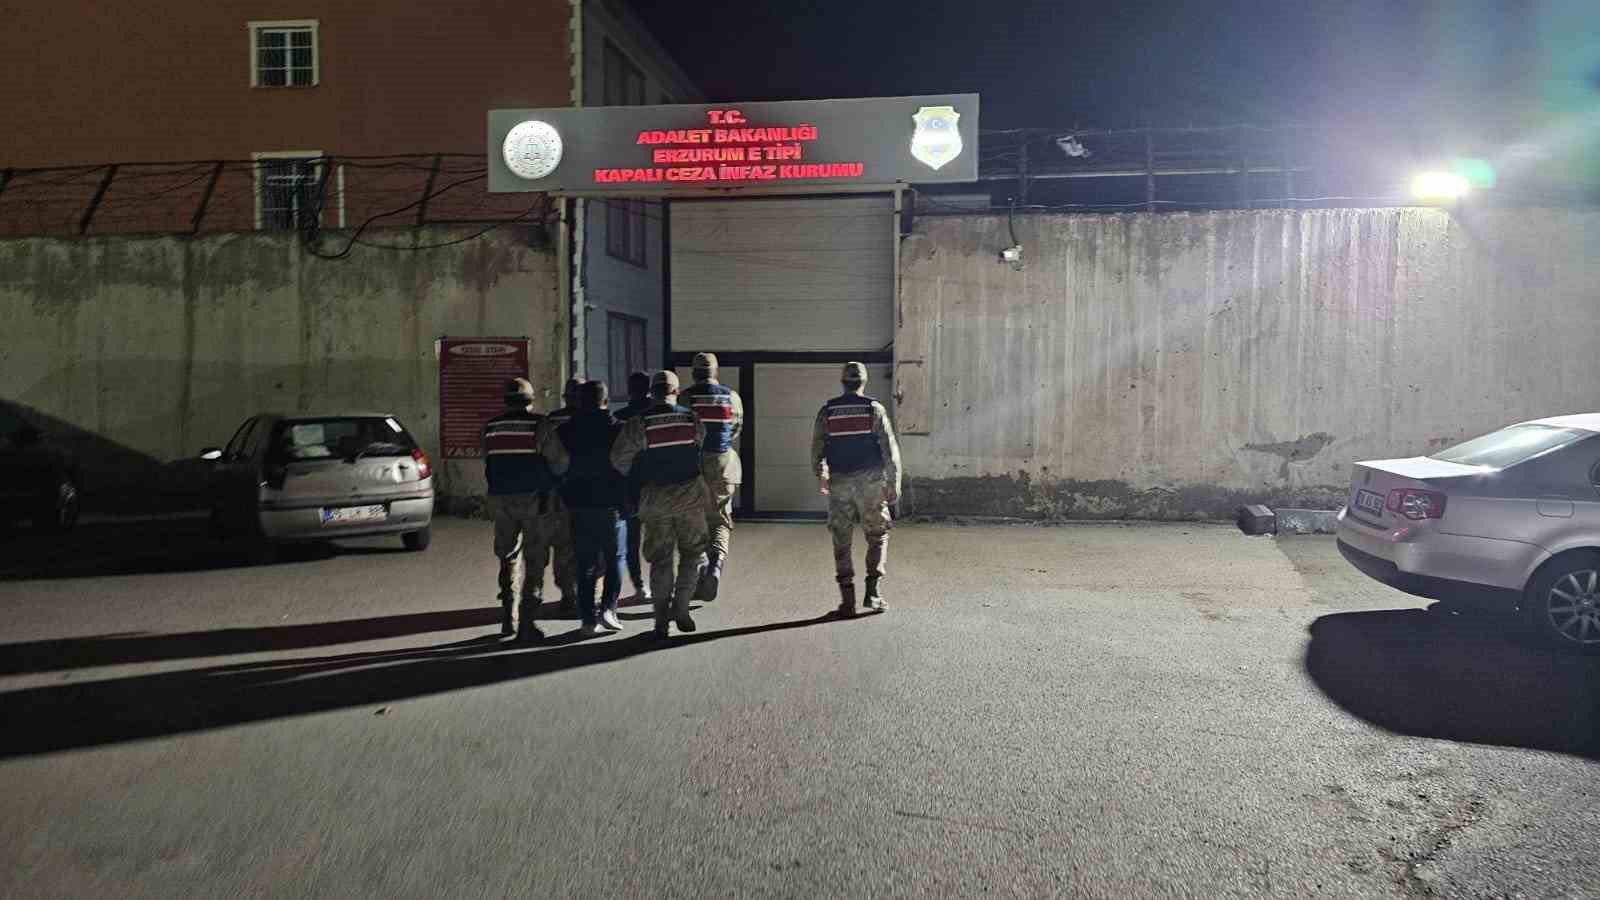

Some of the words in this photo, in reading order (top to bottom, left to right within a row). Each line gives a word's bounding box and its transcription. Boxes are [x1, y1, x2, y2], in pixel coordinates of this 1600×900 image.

[707, 109, 746, 124] T.C.
[636, 130, 712, 144] ADALET
[714, 124, 818, 142] BAKANLIĞI
[653, 147, 744, 163] ERZURUM
[749, 146, 761, 161] E
[764, 143, 802, 160] TİPİ
[594, 169, 663, 182] KAPALI
[667, 166, 717, 181] CEZA
[719, 163, 777, 180] İNFAZ
[780, 162, 865, 178] KURUMU
